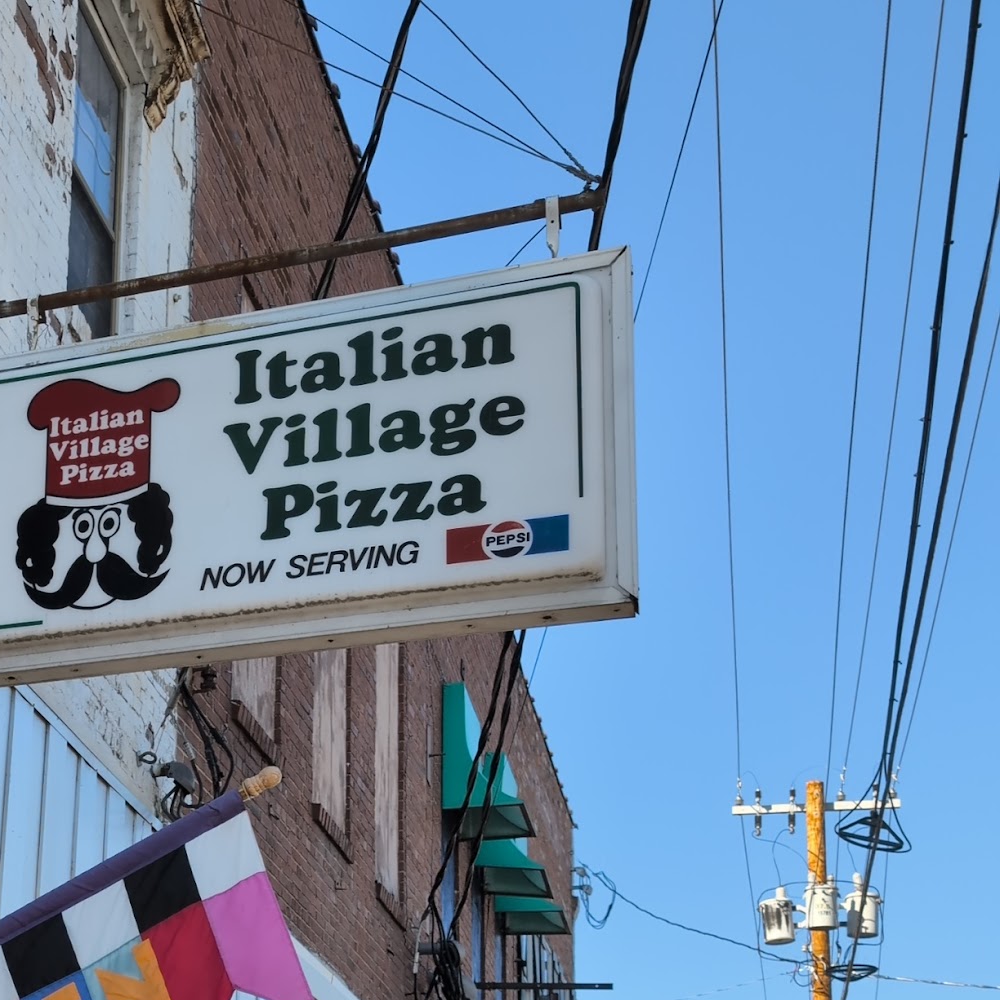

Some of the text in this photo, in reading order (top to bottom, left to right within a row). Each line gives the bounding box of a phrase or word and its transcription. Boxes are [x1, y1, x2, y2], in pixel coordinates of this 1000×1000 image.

[234, 322, 515, 405] Italian
[48, 408, 145, 439] Italian
[223, 395, 526, 475] Village
[49, 430, 150, 462] Village
[59, 459, 136, 486] Pizza
[260, 473, 487, 541] Pizza
[484, 530, 531, 548] PEPSI
[200, 541, 419, 591] NOW SERVING
